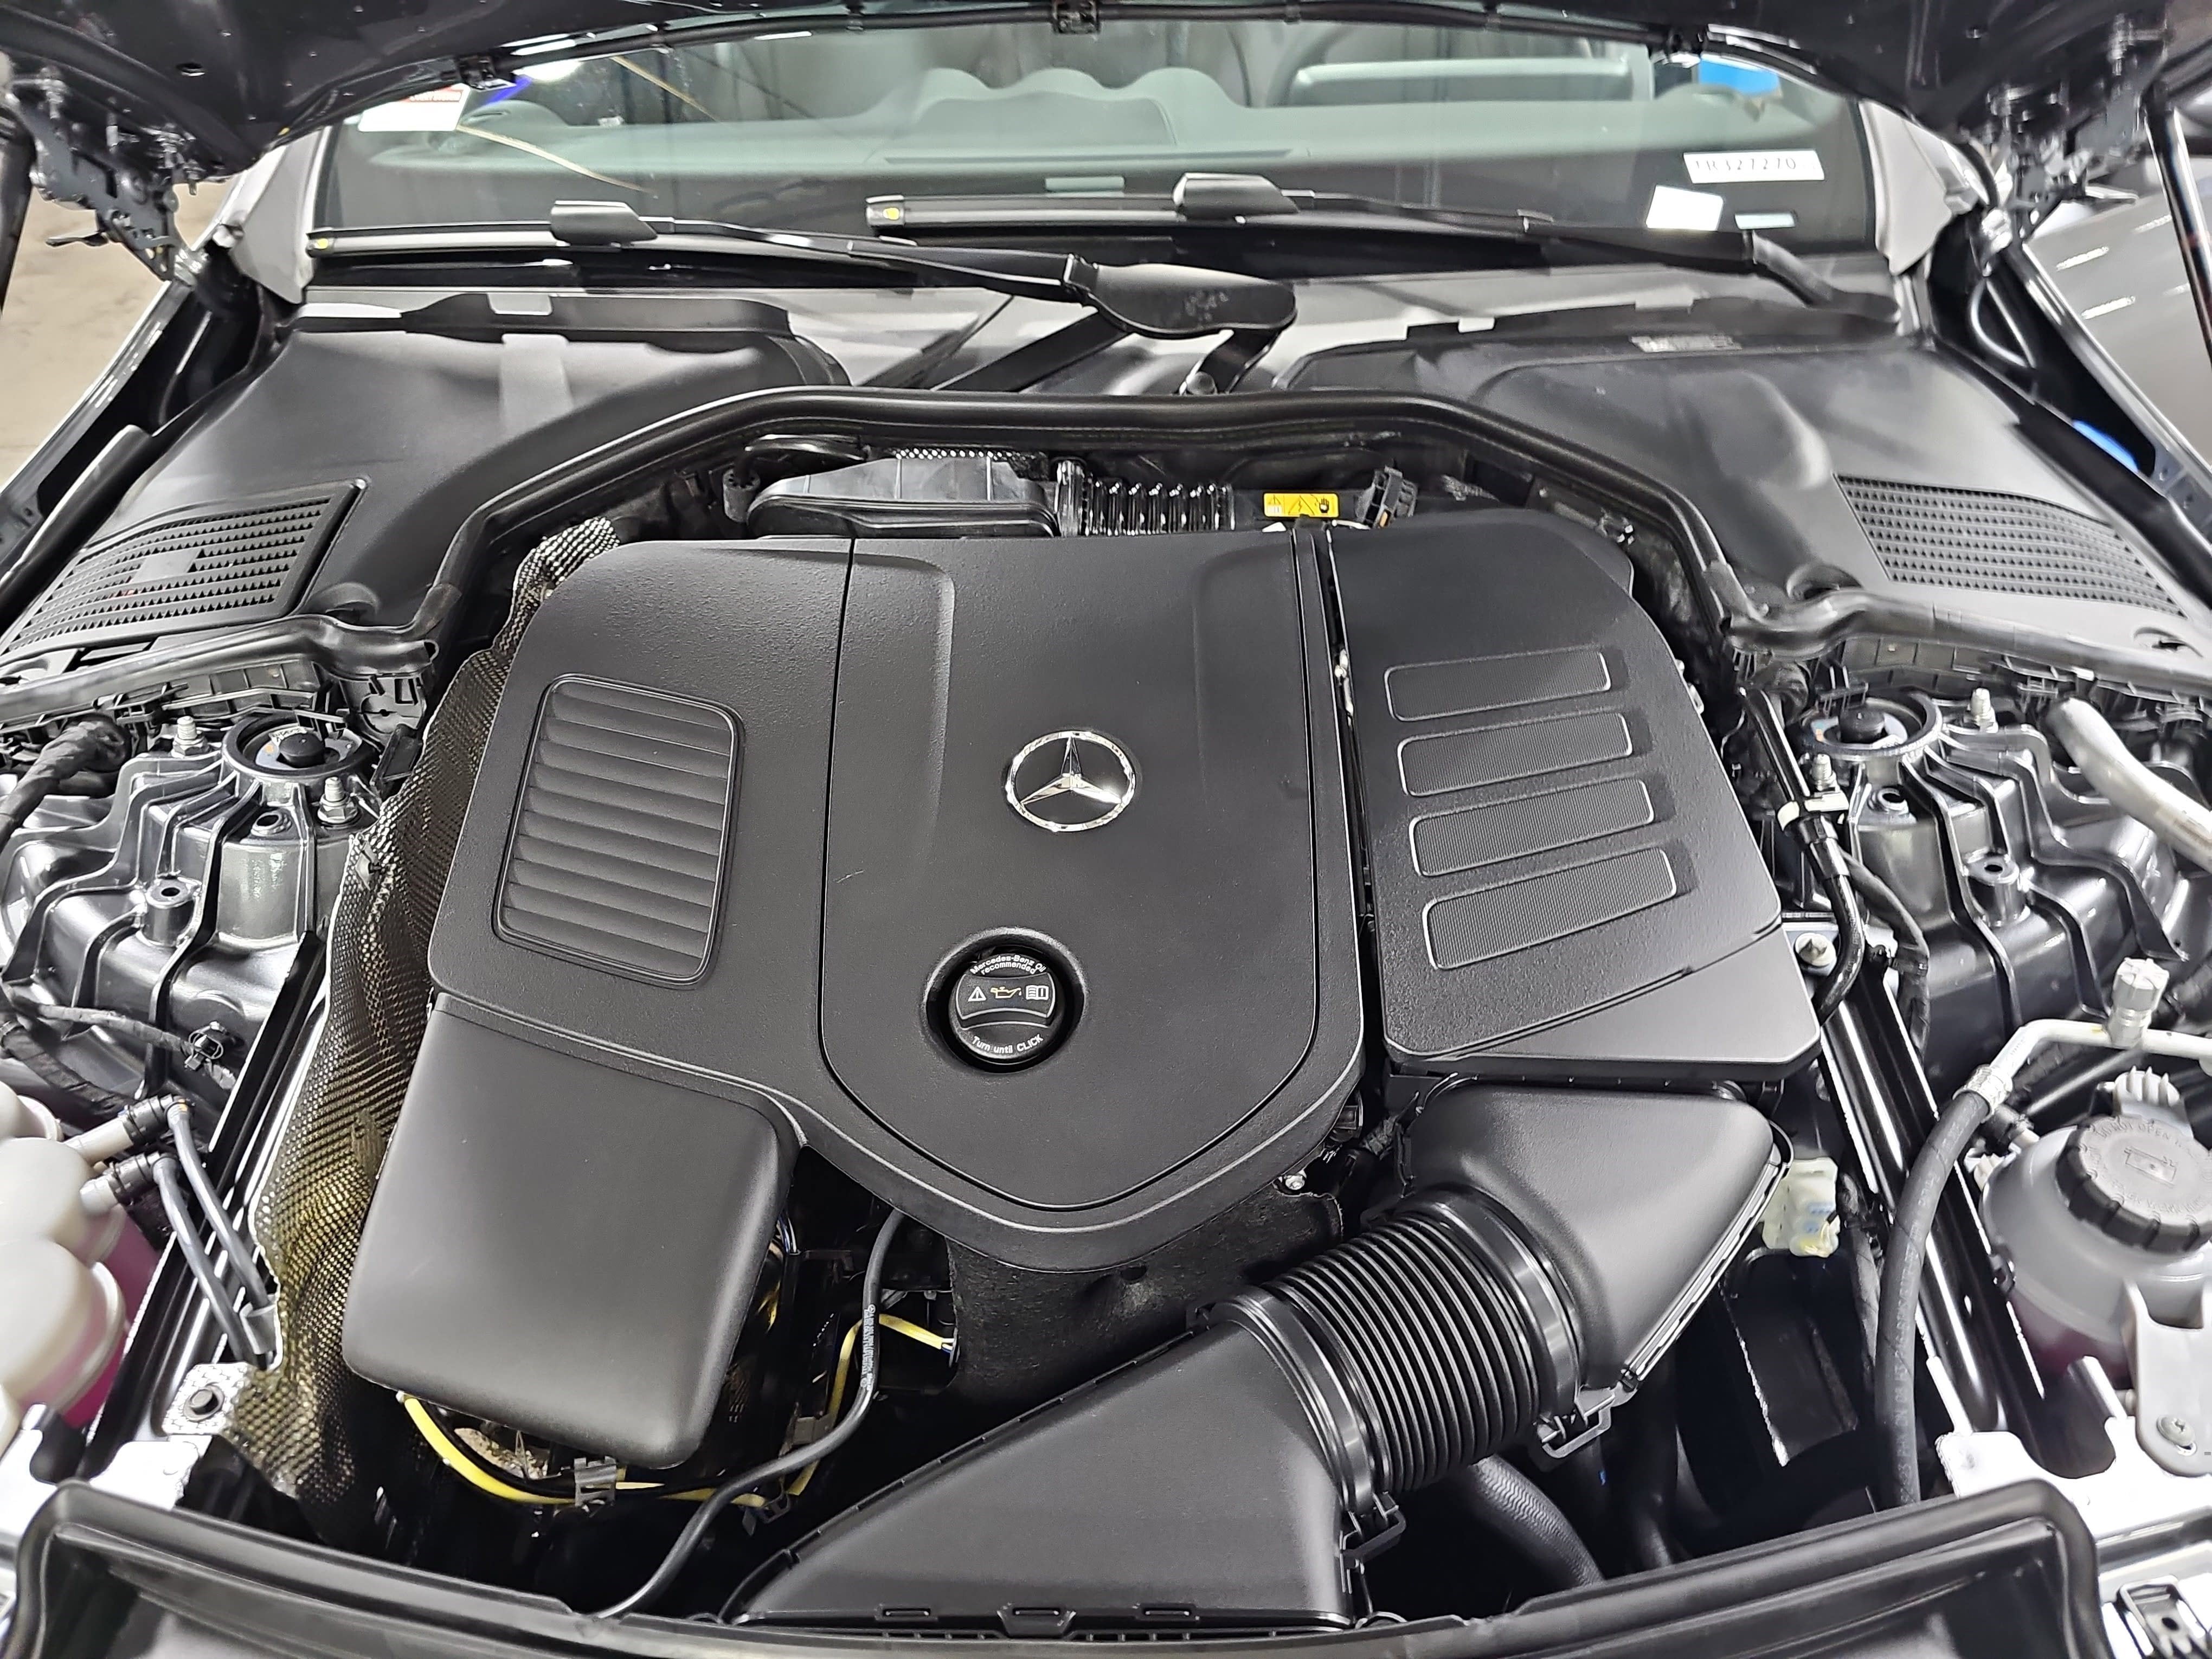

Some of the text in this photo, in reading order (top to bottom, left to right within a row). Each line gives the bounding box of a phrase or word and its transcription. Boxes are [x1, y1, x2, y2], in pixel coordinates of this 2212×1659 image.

[970, 954, 1047, 975] Mercedes-Benz Oil
[981, 961, 1037, 975] recommended
[972, 1033, 1044, 1053] Turn until CLICK
[2138, 1123, 2169, 1140] OPEN
